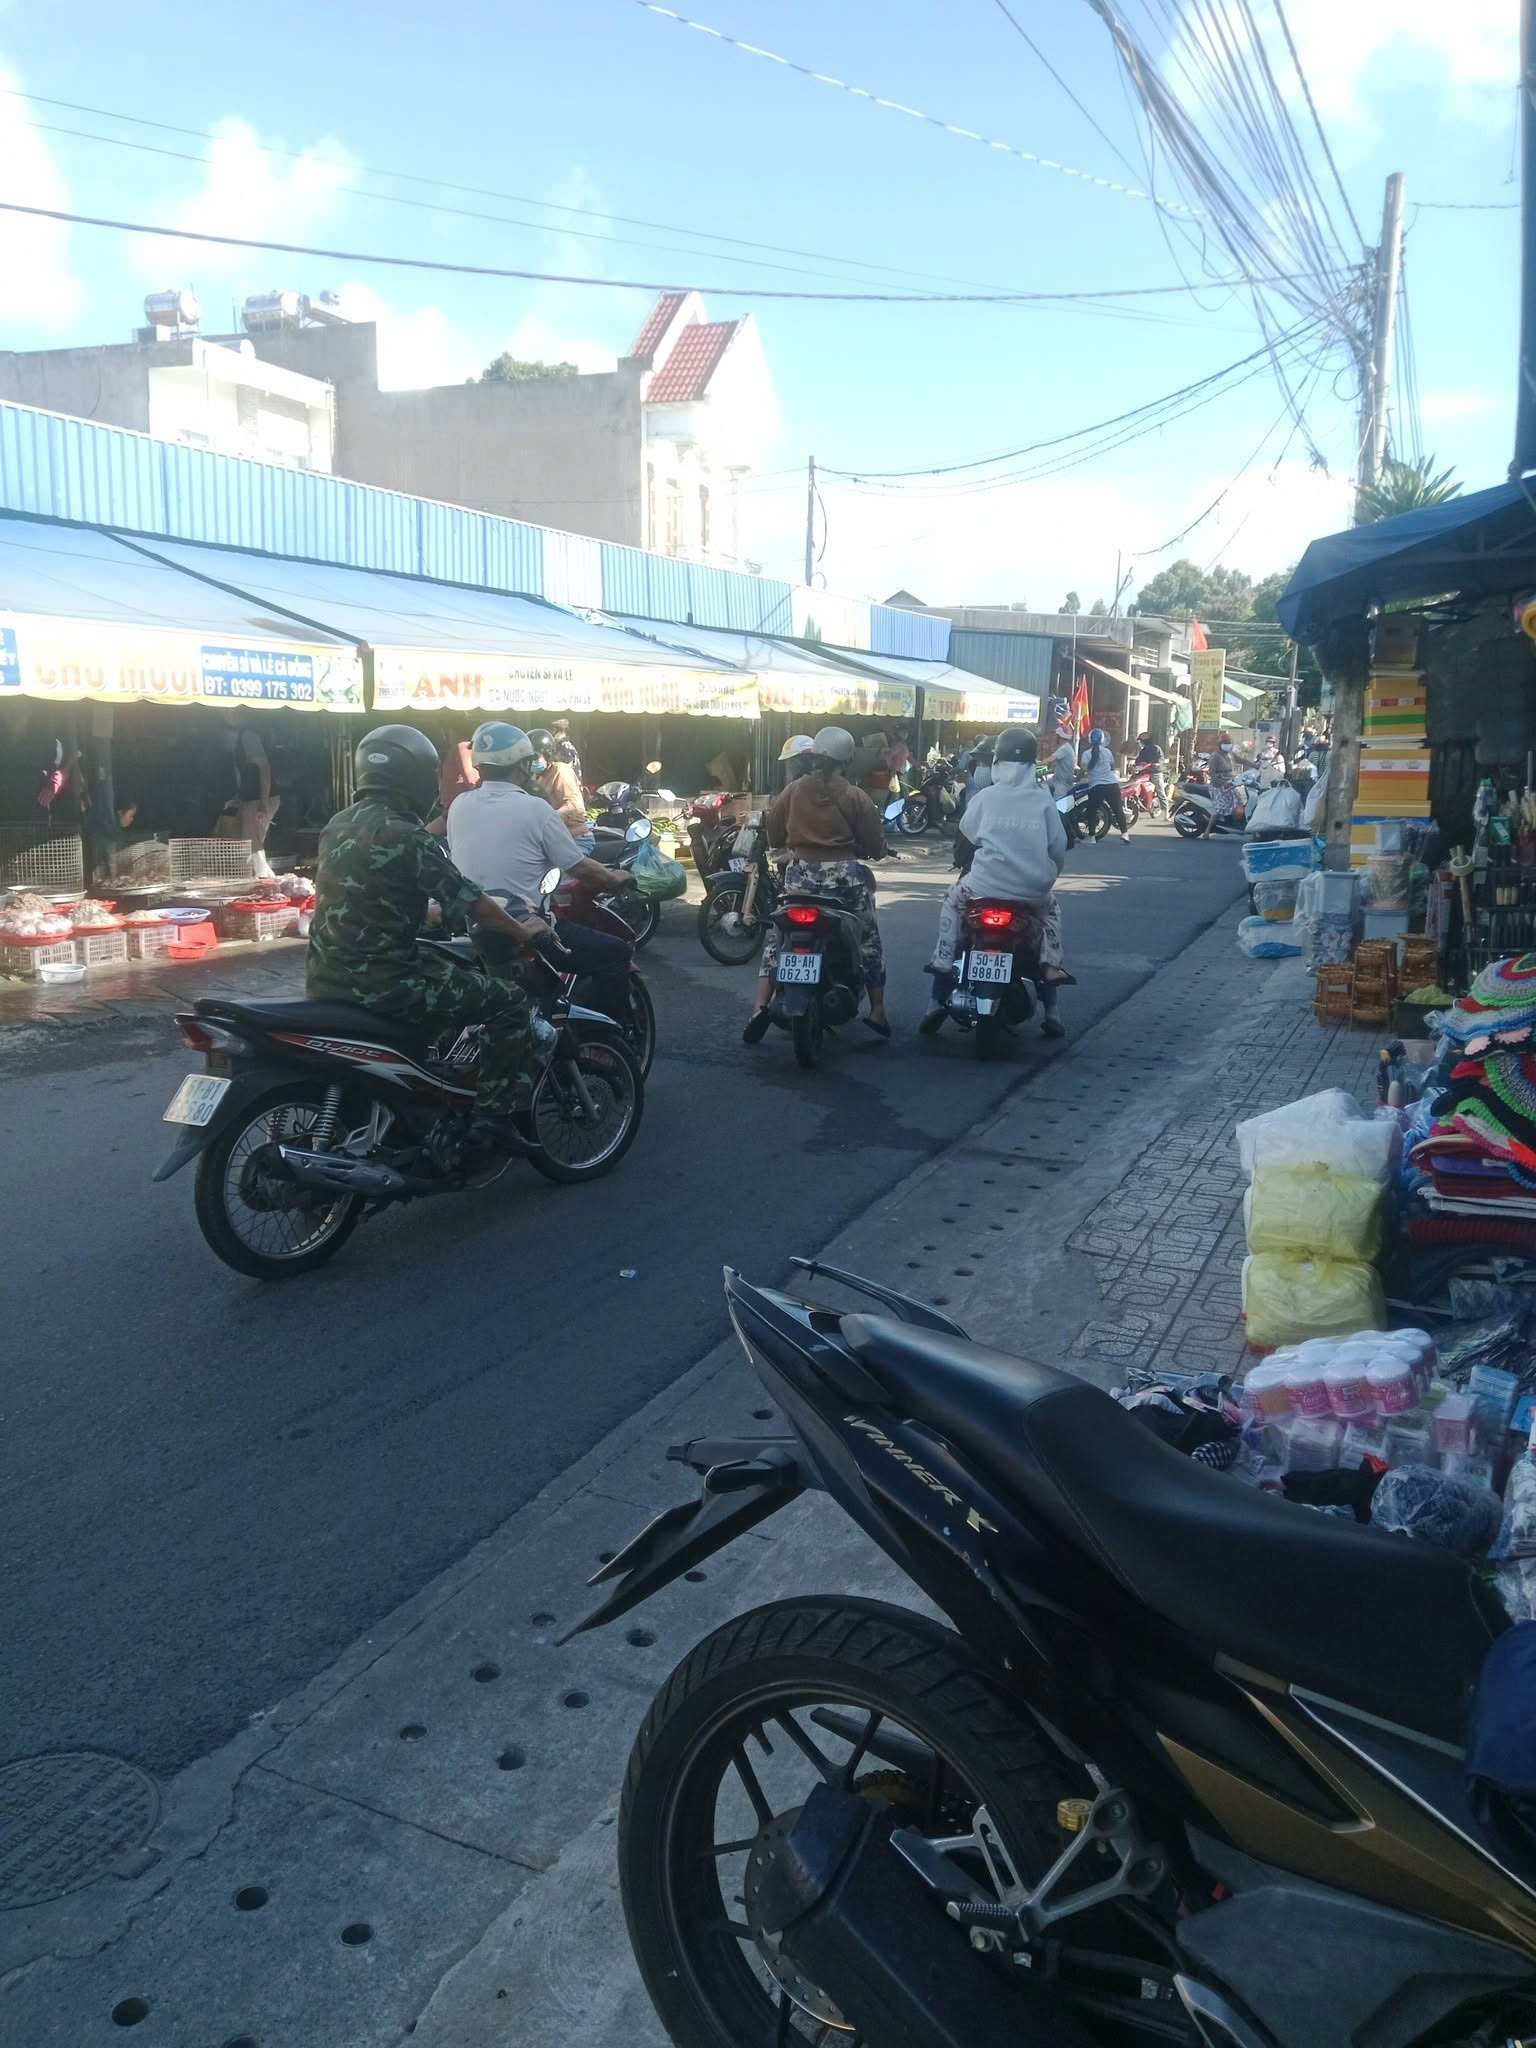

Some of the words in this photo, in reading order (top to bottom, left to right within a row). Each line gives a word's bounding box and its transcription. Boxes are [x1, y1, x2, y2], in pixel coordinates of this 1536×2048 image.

[231, 678, 263, 697] 0399
[265, 680, 288, 699] 175
[290, 682, 312, 700] 302
[785, 955, 815, 968] 69-AH
[976, 954, 1006, 967] 50-AE
[780, 968, 817, 981] 062.31
[972, 966, 1007, 981] 988.01
[843, 1415, 962, 1506] WINNER
